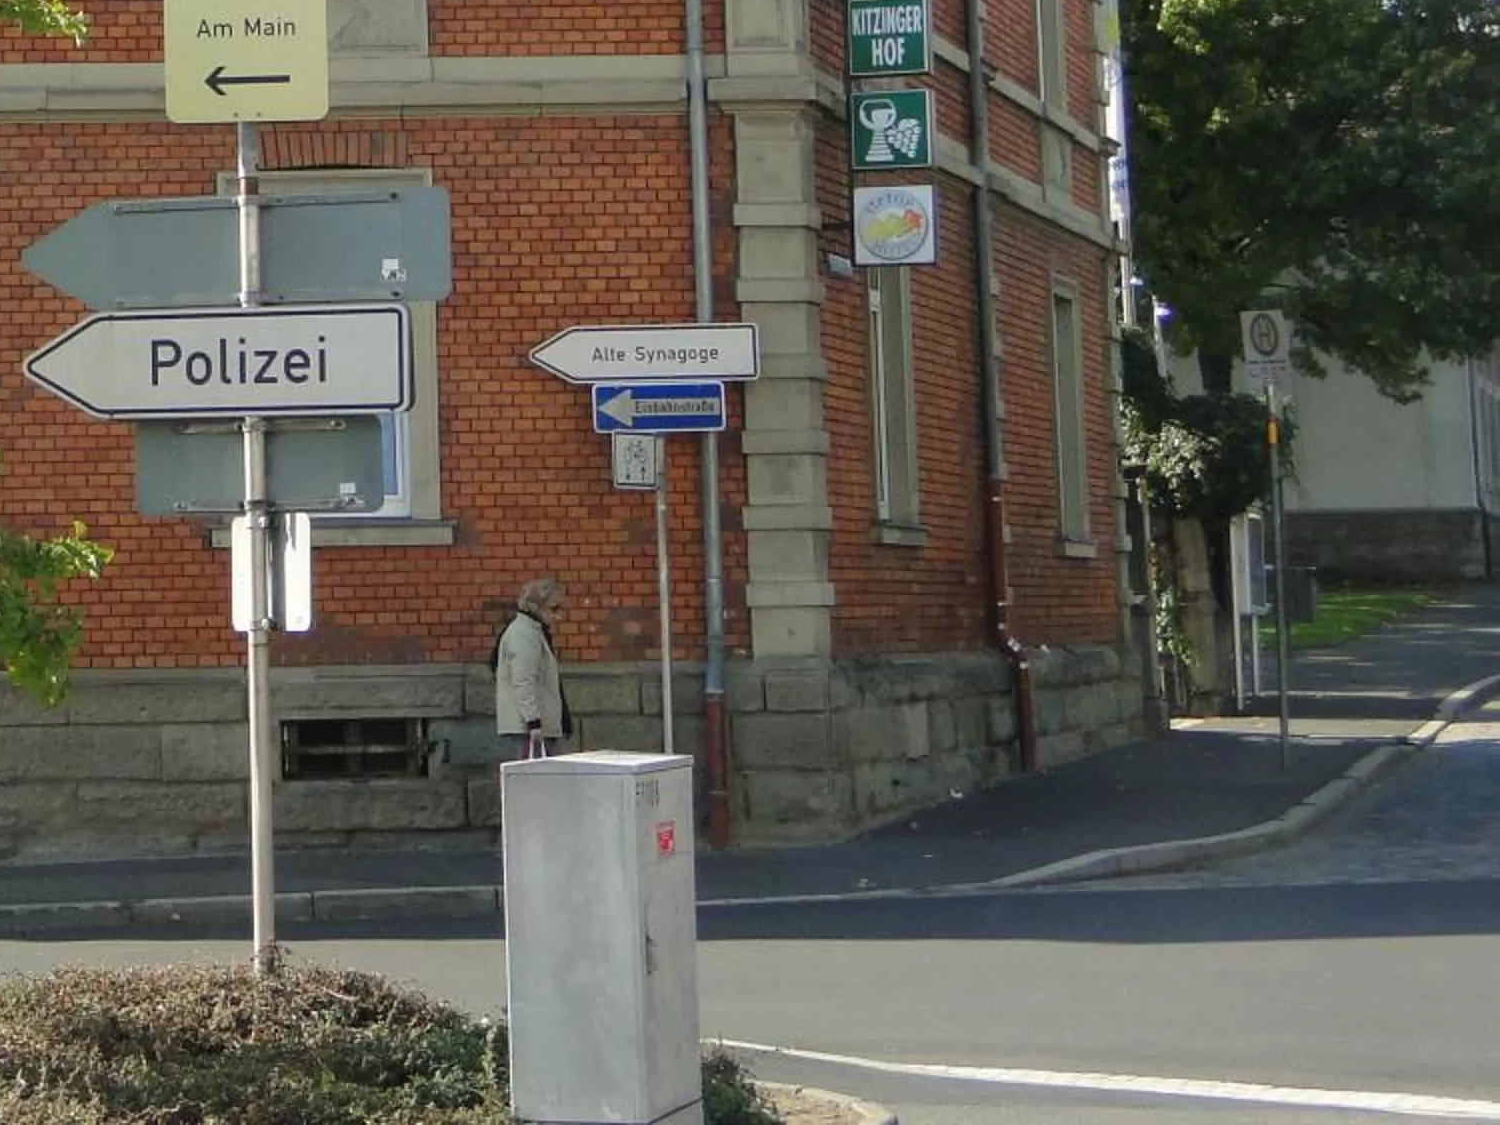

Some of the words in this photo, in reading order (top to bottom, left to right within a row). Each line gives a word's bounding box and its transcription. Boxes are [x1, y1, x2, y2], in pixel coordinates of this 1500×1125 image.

[197, 18, 233, 38] Am
[244, 16, 296, 37] Main
[851, 5, 922, 36] KITZINGER
[871, 37, 905, 67] HOF
[150, 334, 327, 387] Polizei
[592, 346, 626, 363] Alte
[635, 345, 719, 364] Synagoge
